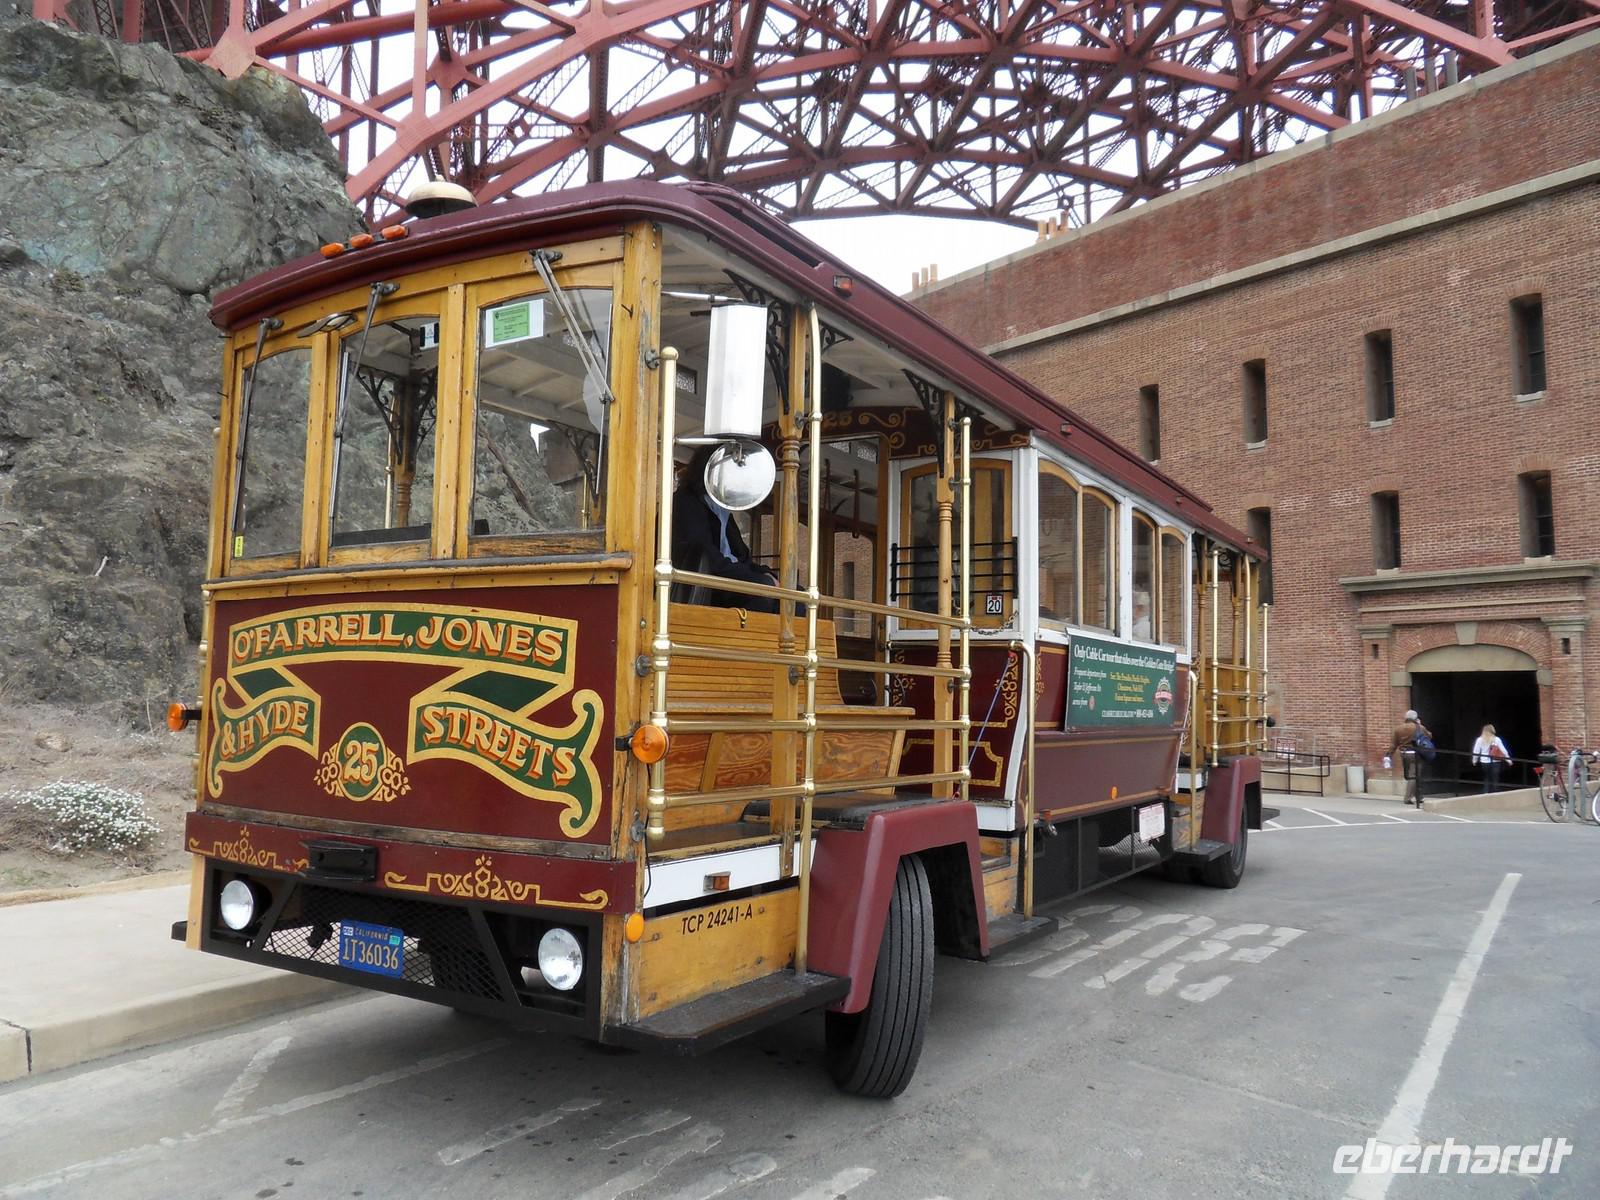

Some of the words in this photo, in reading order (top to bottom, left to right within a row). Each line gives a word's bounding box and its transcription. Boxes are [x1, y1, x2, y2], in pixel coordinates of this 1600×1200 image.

[988, 599, 1001, 612] 20
[416, 617, 565, 666] JONES
[220, 728, 236, 760] &
[237, 700, 310, 752] HYDE
[421, 705, 577, 787] STREETS
[343, 739, 379, 785] 25
[682, 914, 704, 935] TCP
[707, 904, 753, 929] 24241-A
